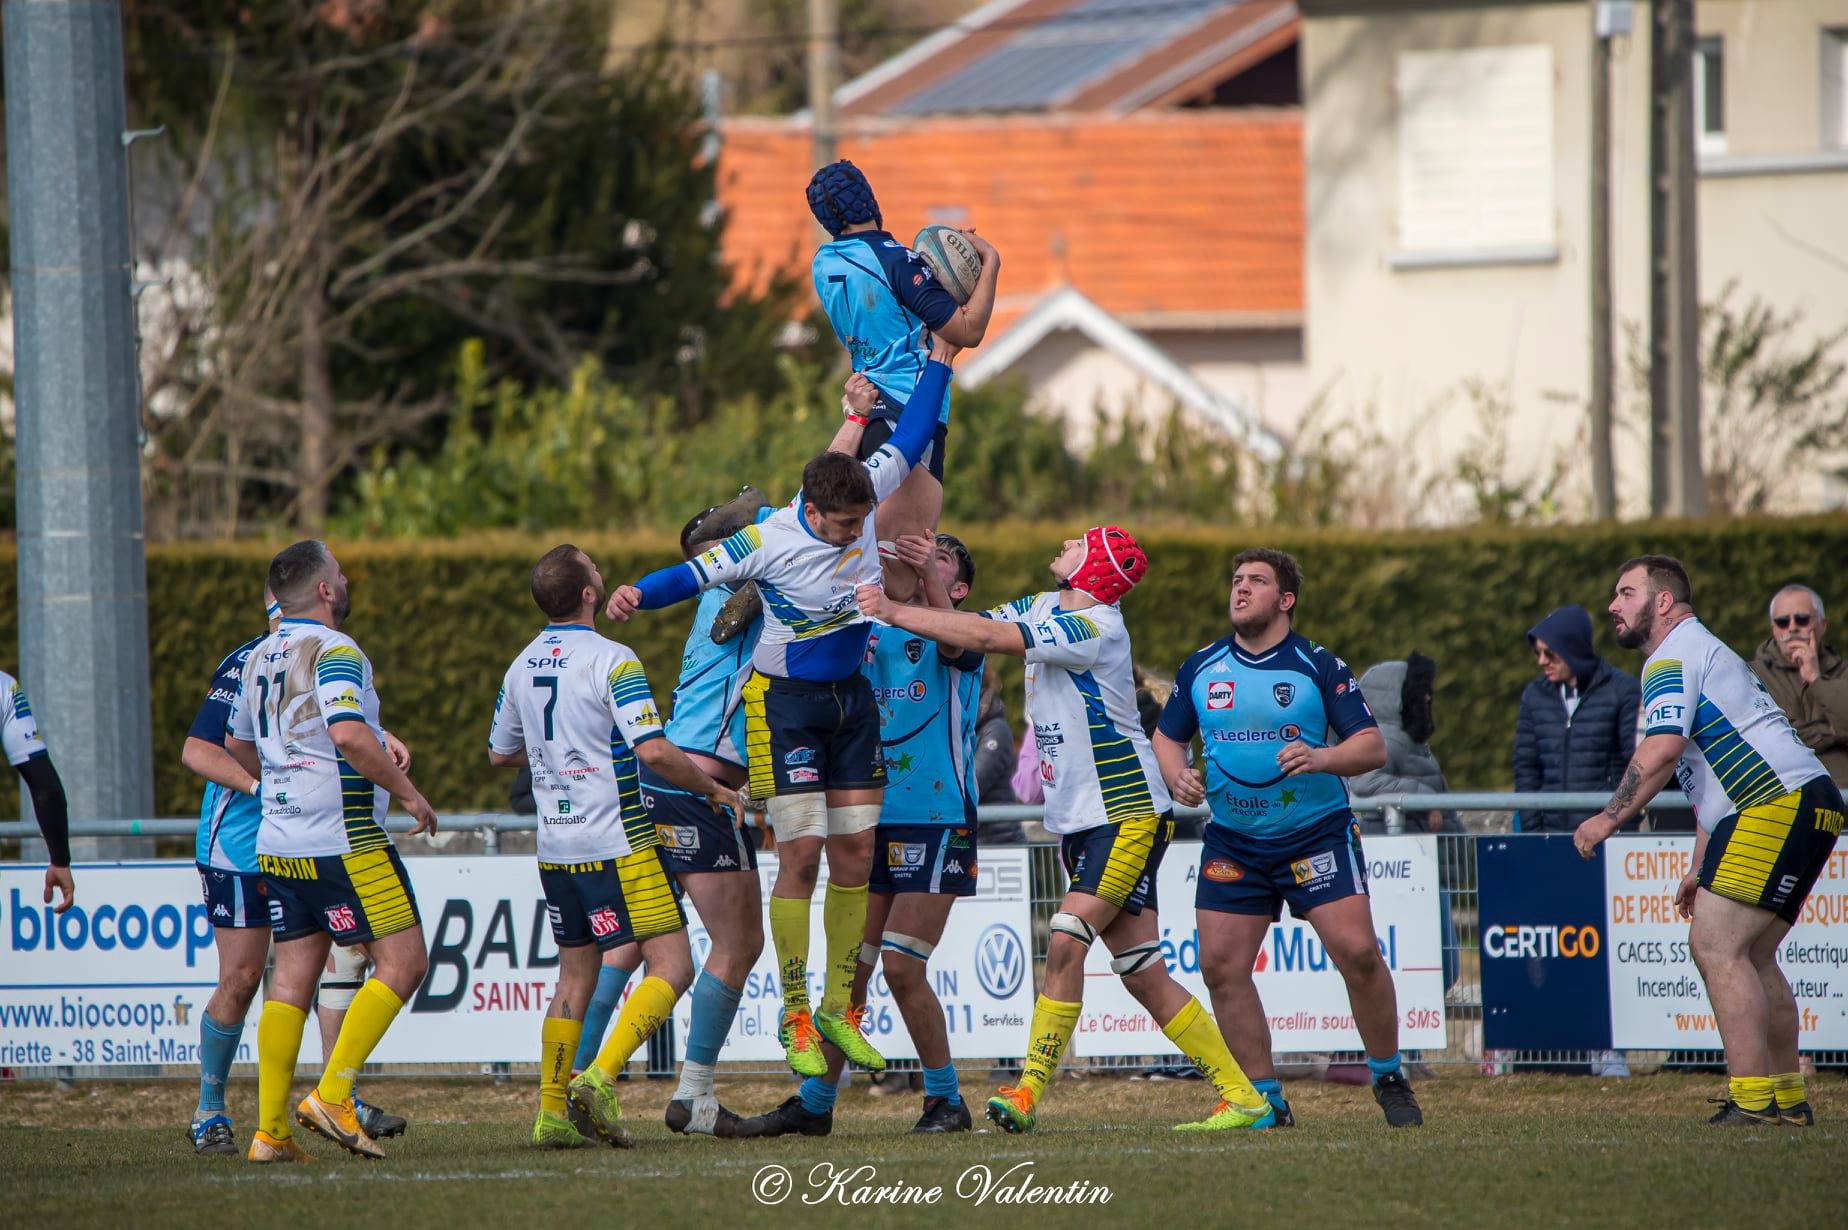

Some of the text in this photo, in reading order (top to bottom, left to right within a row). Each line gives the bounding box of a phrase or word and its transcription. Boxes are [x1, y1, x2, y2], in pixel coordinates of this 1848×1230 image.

[1209, 691, 1232, 700] DARTY
[533, 676, 558, 741] 7
[544, 816, 587, 825] Andriollo
[1624, 851, 1689, 881] CENTRE
[1613, 895, 1635, 924] DE
[10, 888, 214, 966] biocoop
[1484, 924, 1600, 959] CERTIGO
[1638, 976, 1701, 1000] Incendie,
[983, 1013, 1024, 1027] Services
[1079, 1015, 1097, 1033] Le
[1102, 1012, 1147, 1033] Crédit
[1406, 1009, 1441, 1030] SMS
[73, 1040, 95, 1063] 38
